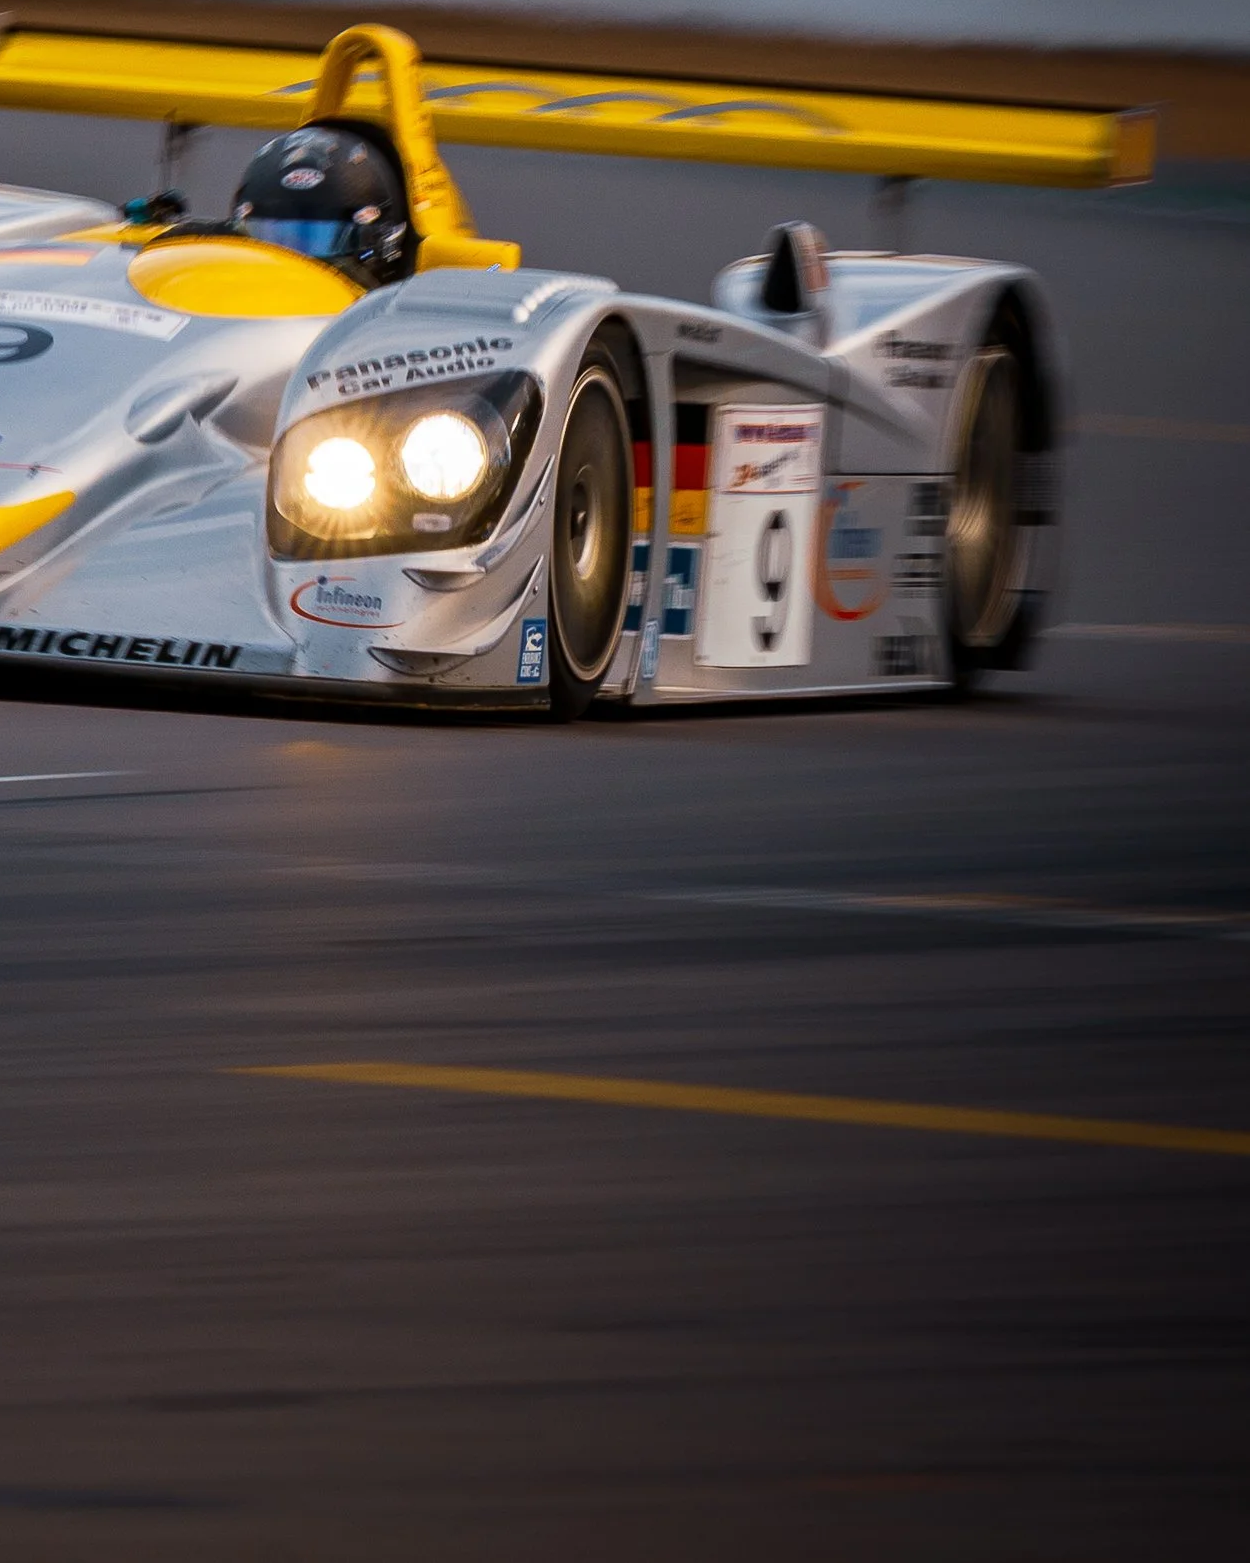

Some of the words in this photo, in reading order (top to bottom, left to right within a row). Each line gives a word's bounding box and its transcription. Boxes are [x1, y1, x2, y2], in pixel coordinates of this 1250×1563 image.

[306, 336, 514, 391] Panasonic
[337, 374, 393, 396] Car
[405, 356, 495, 382] Audio
[750, 509, 793, 653] 9
